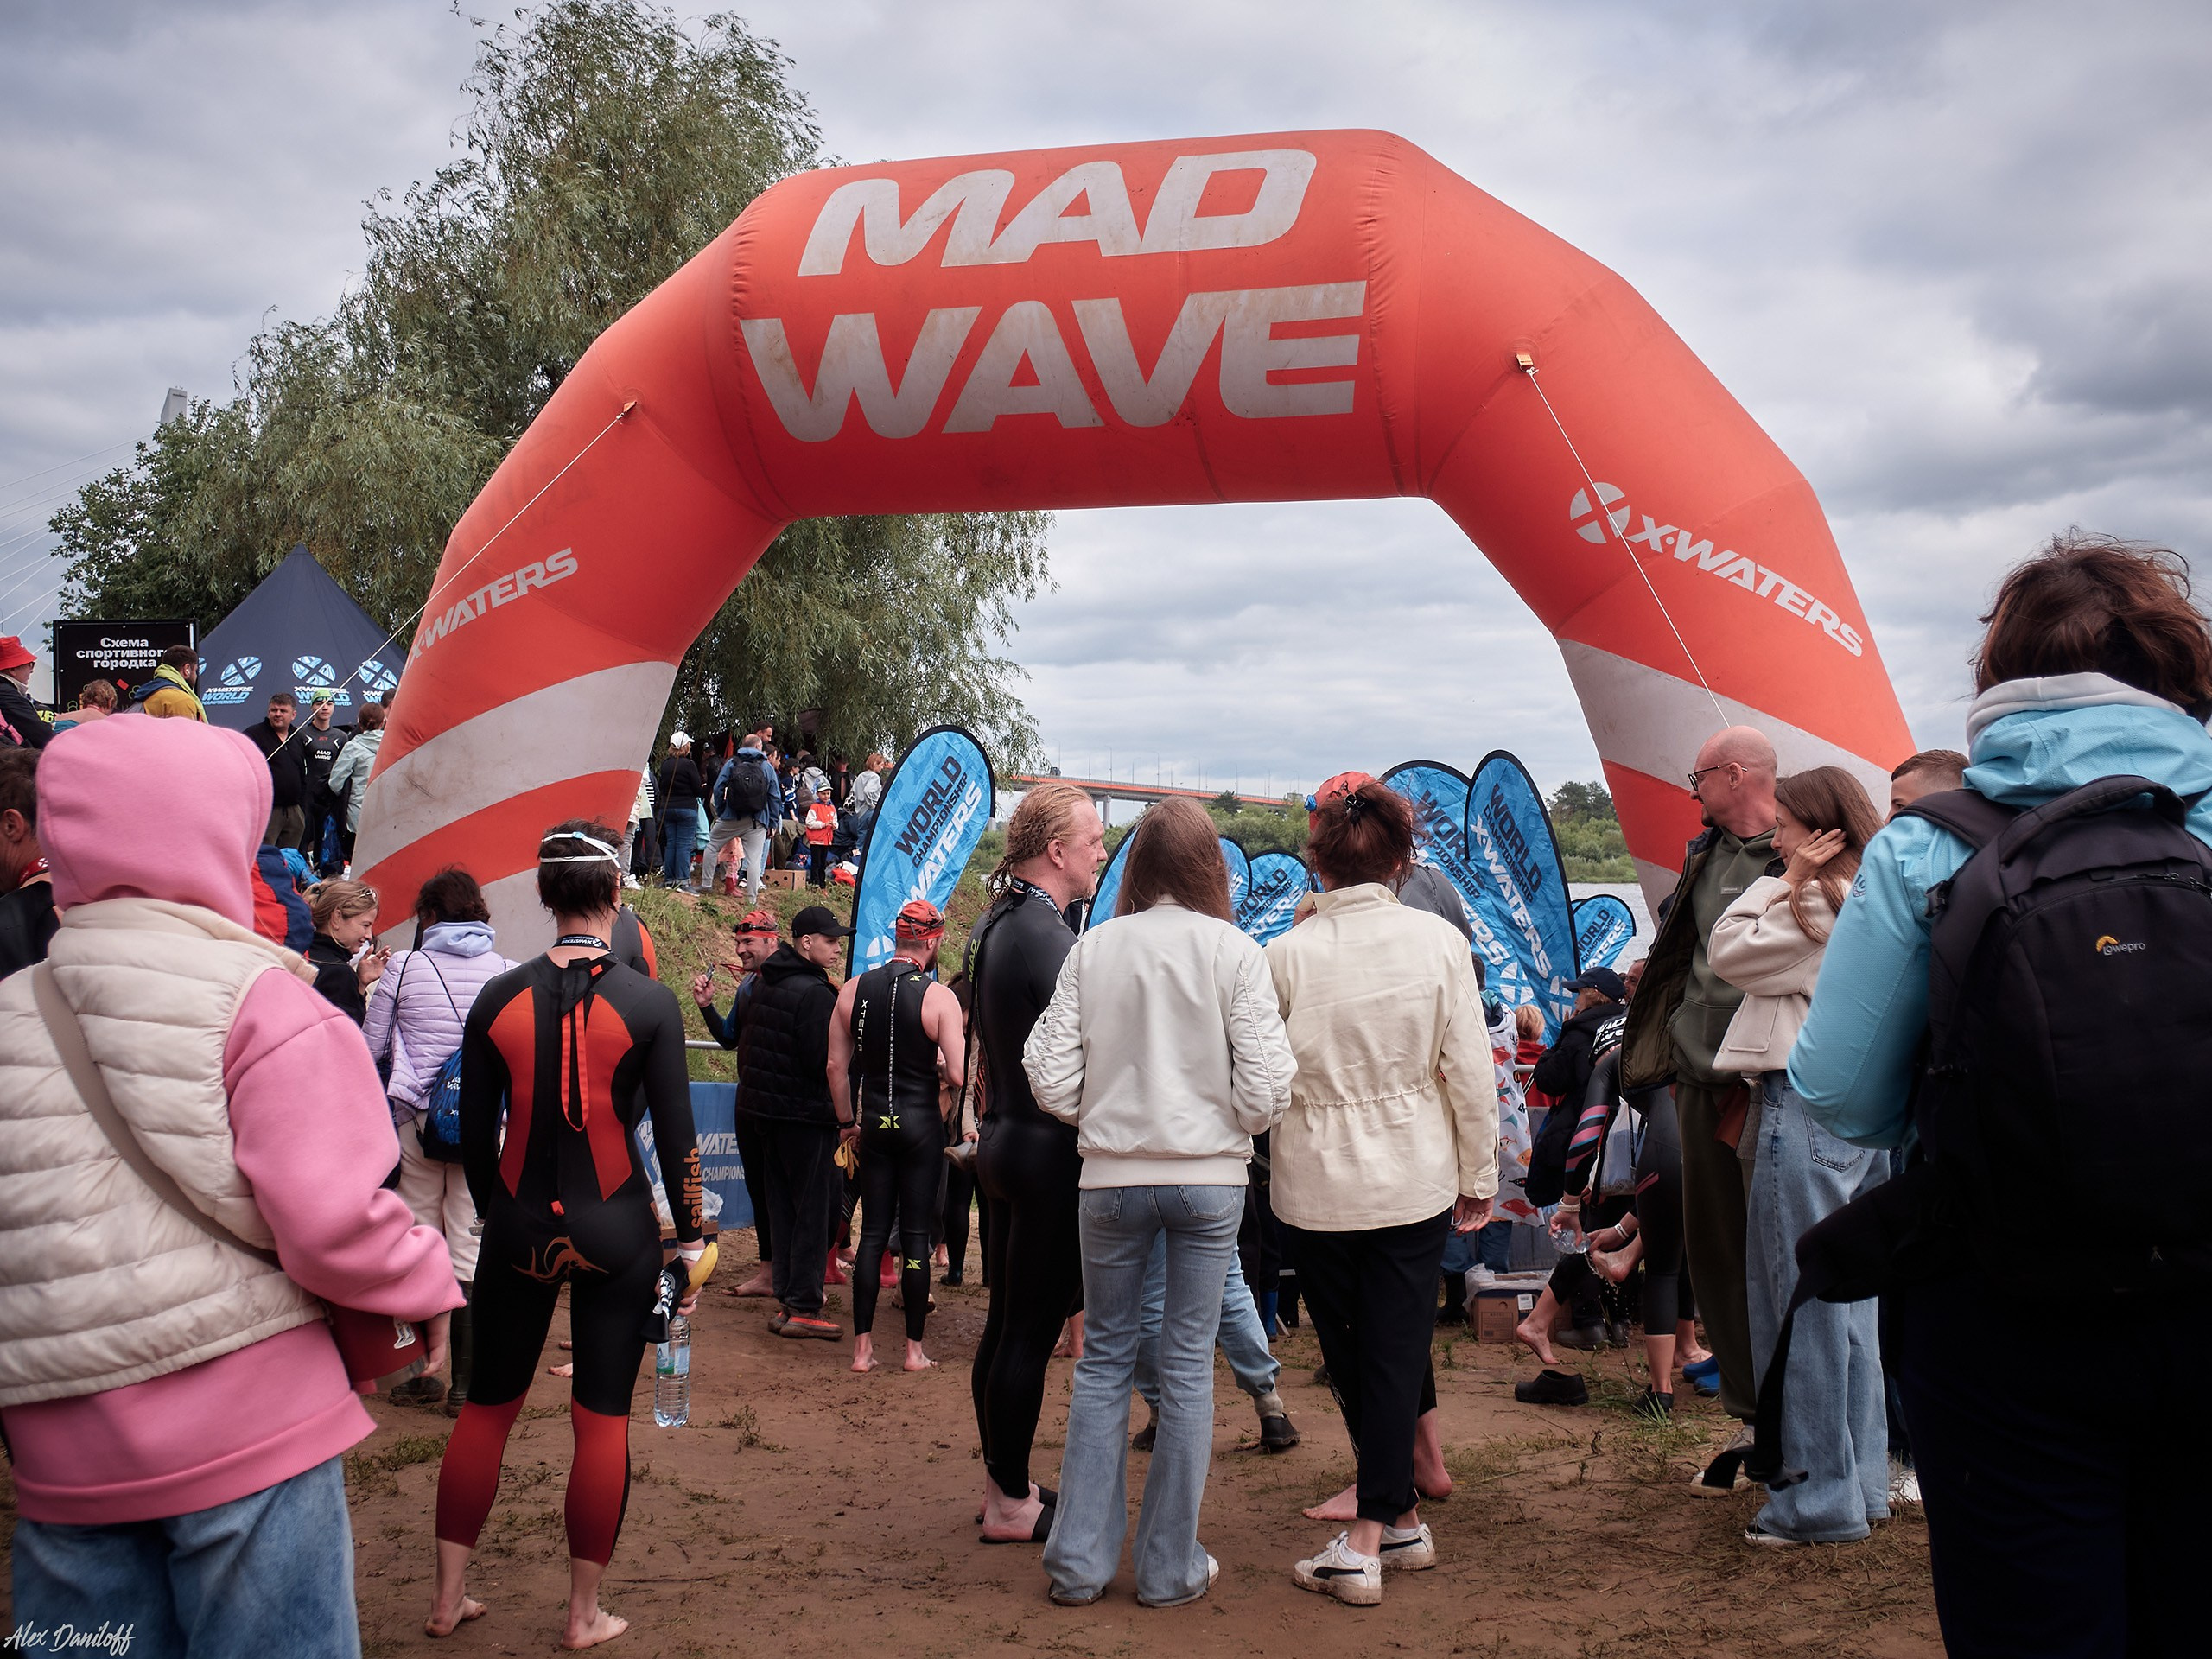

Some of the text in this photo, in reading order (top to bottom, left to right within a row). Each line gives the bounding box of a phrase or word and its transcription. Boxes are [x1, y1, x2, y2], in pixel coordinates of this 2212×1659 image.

[797, 149, 1317, 276] MAD
[740, 280, 1367, 442] WAVE
[76, 650, 167, 660] спортивног
[93, 659, 156, 670] городка
[99, 637, 149, 648] Схема
[201, 692, 250, 701] WORLD
[894, 755, 962, 856] WORLD
[912, 772, 968, 868] CHAMPIONSHIP
[1490, 783, 1542, 893] WORLD
[1483, 804, 1533, 904] CHAMPIONSHIP
[1239, 879, 1293, 931] CHAMPIONSHIP
[683, 1147, 702, 1229] sailfish
